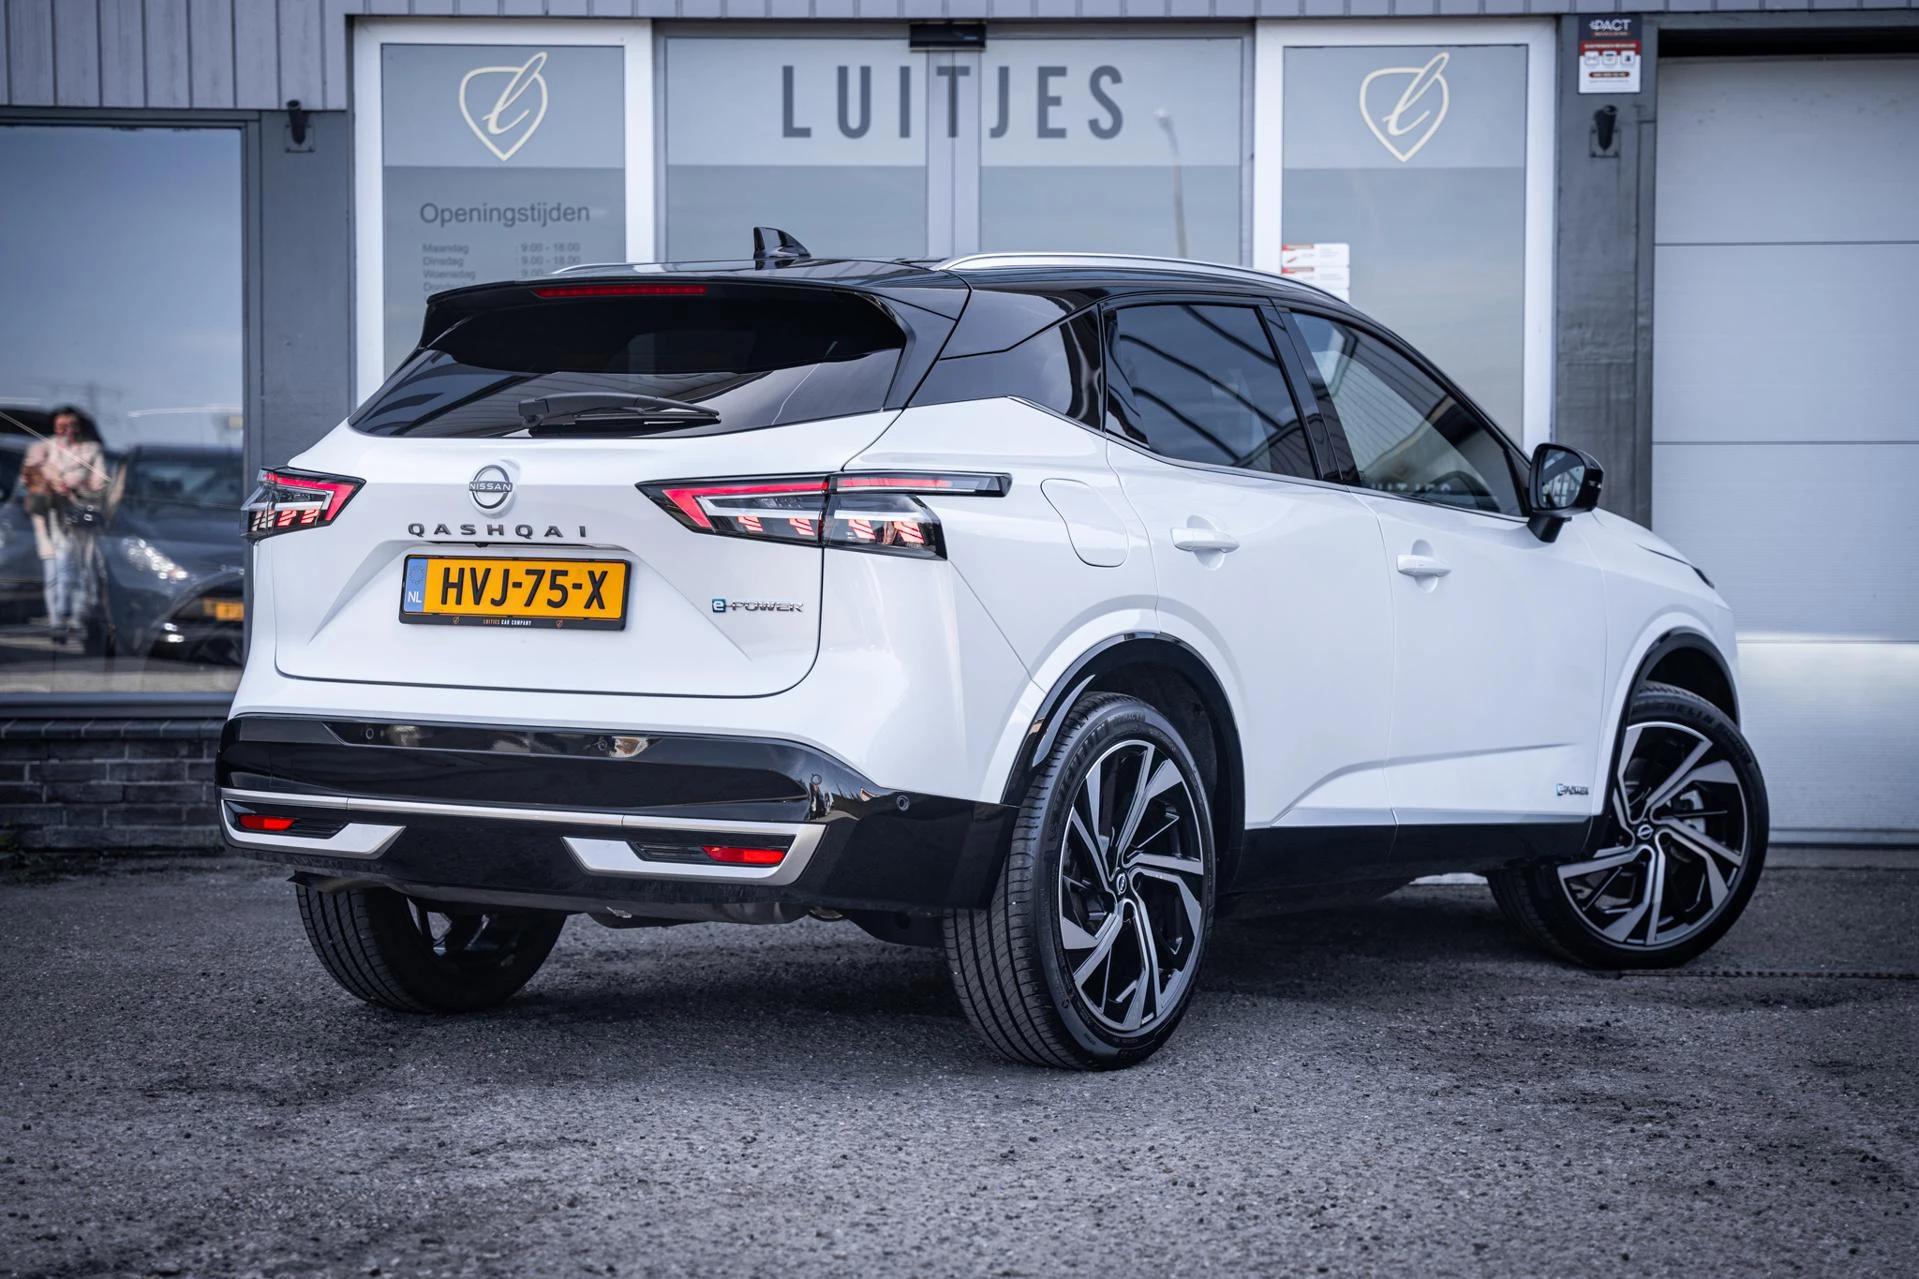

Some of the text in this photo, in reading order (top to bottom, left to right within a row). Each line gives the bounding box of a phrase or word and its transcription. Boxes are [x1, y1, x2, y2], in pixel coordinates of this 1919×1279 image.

[782, 65, 1124, 140] LUITJES
[419, 202, 591, 228] Openingstijden
[422, 242, 470, 256] Maandag
[422, 256, 465, 269] Dinsdag
[469, 482, 512, 491] NISSAN
[407, 522, 588, 540] QASHQAI
[407, 566, 609, 610] NL HVJ-75-X
